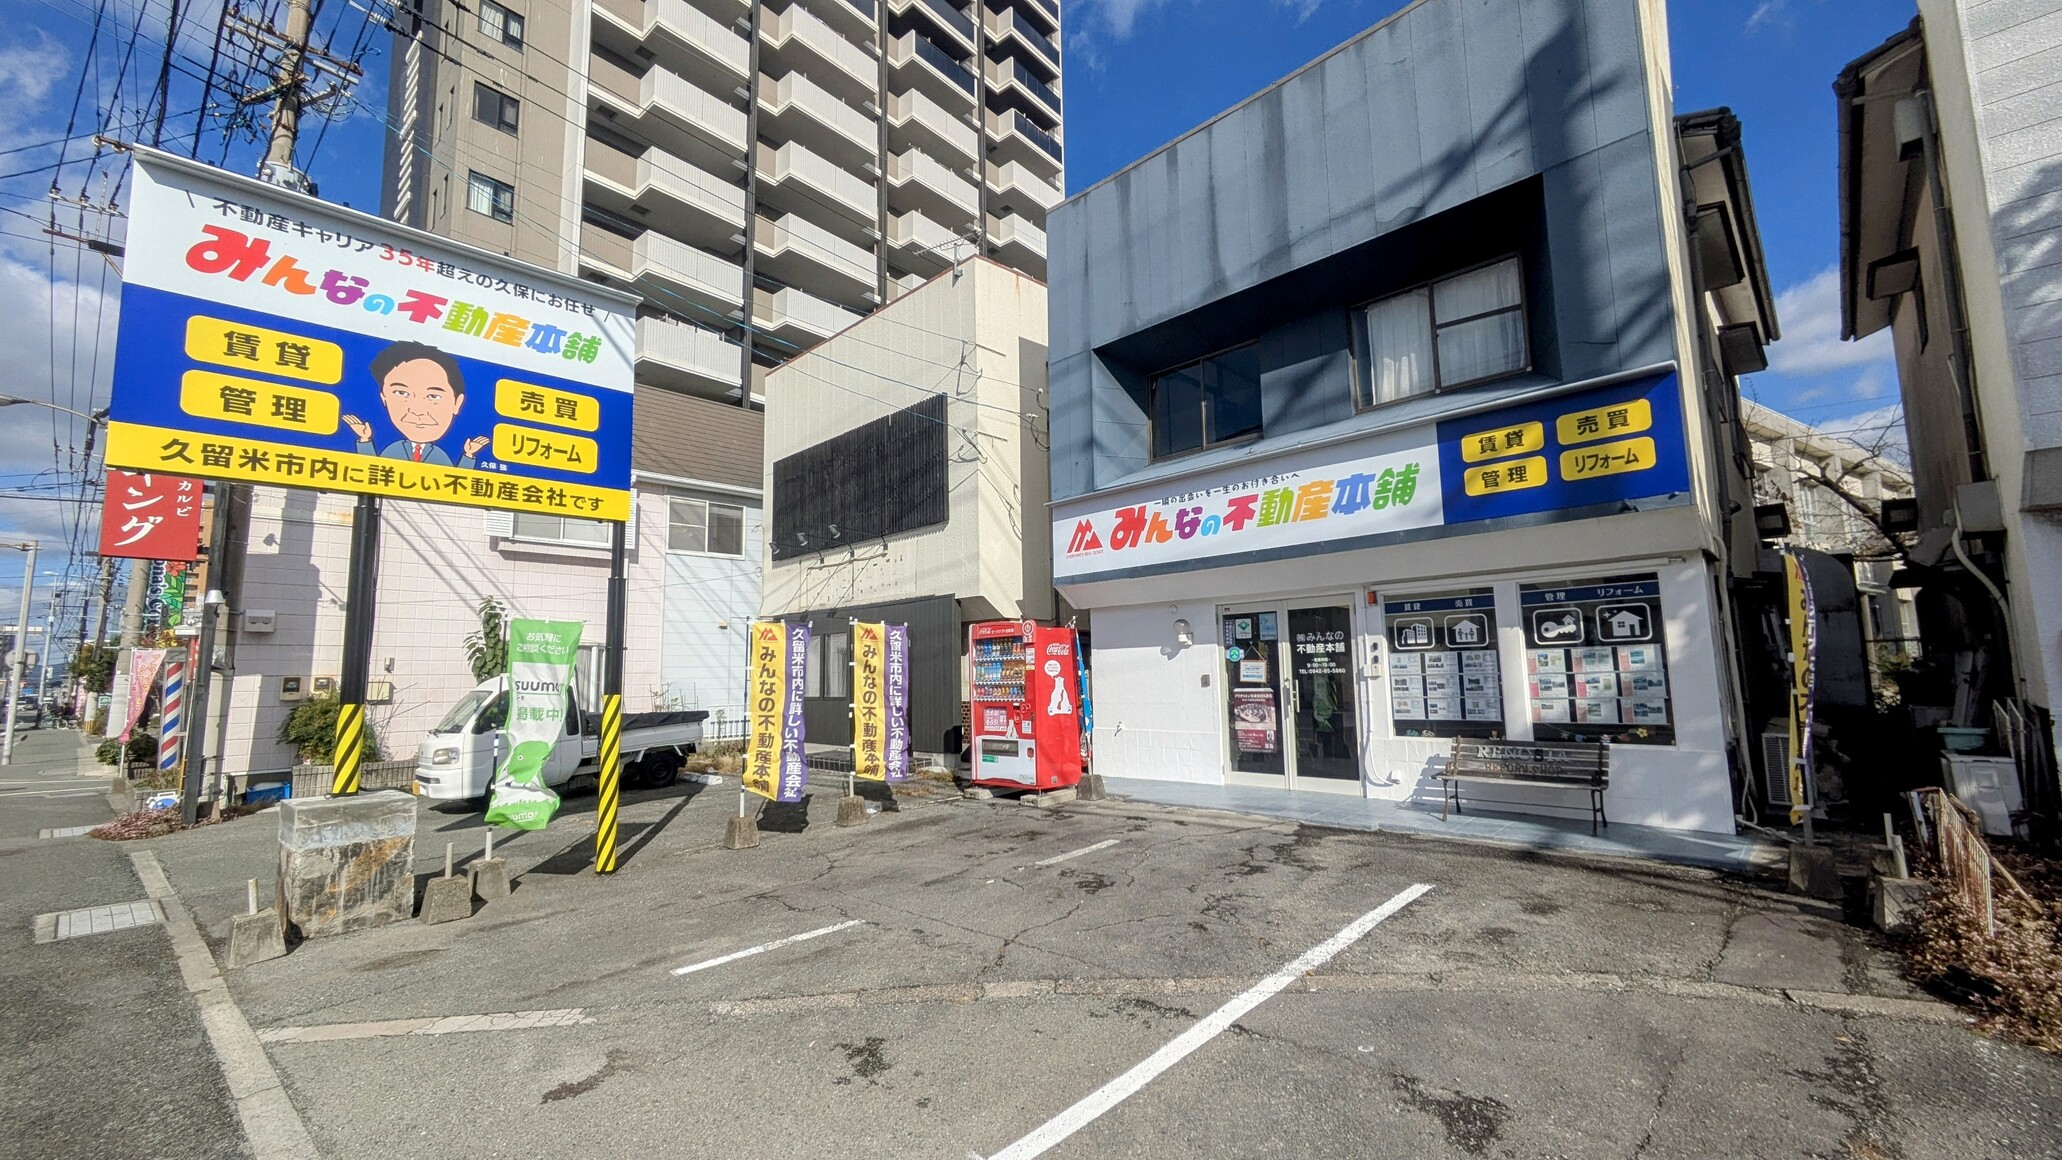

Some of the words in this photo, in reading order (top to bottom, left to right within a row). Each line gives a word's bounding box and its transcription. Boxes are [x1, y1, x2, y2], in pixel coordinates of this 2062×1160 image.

[185, 224, 602, 365] みんなの不動産本舗
[223, 330, 311, 371] 賃貸
[219, 385, 307, 424] 管理
[520, 390, 578, 421] 売買
[1576, 408, 1630, 436] 売買
[512, 433, 582, 464] リフォーム
[1478, 429, 1524, 455] 賃貸
[161, 438, 604, 511] 久留米市内に詳しい不動産会社です
[1574, 447, 1639, 474] リフォーム
[1481, 465, 1528, 489] 管理
[1110, 462, 1420, 551] みんなの不動産本舗
[1544, 592, 1566, 601] 管理
[1597, 585, 1644, 597] リフォーム
[1296, 642, 1345, 654] 不動産本舗
[752, 646, 777, 793] みんなの不動産本舗
[862, 644, 880, 777] みんなの不動産本舗
